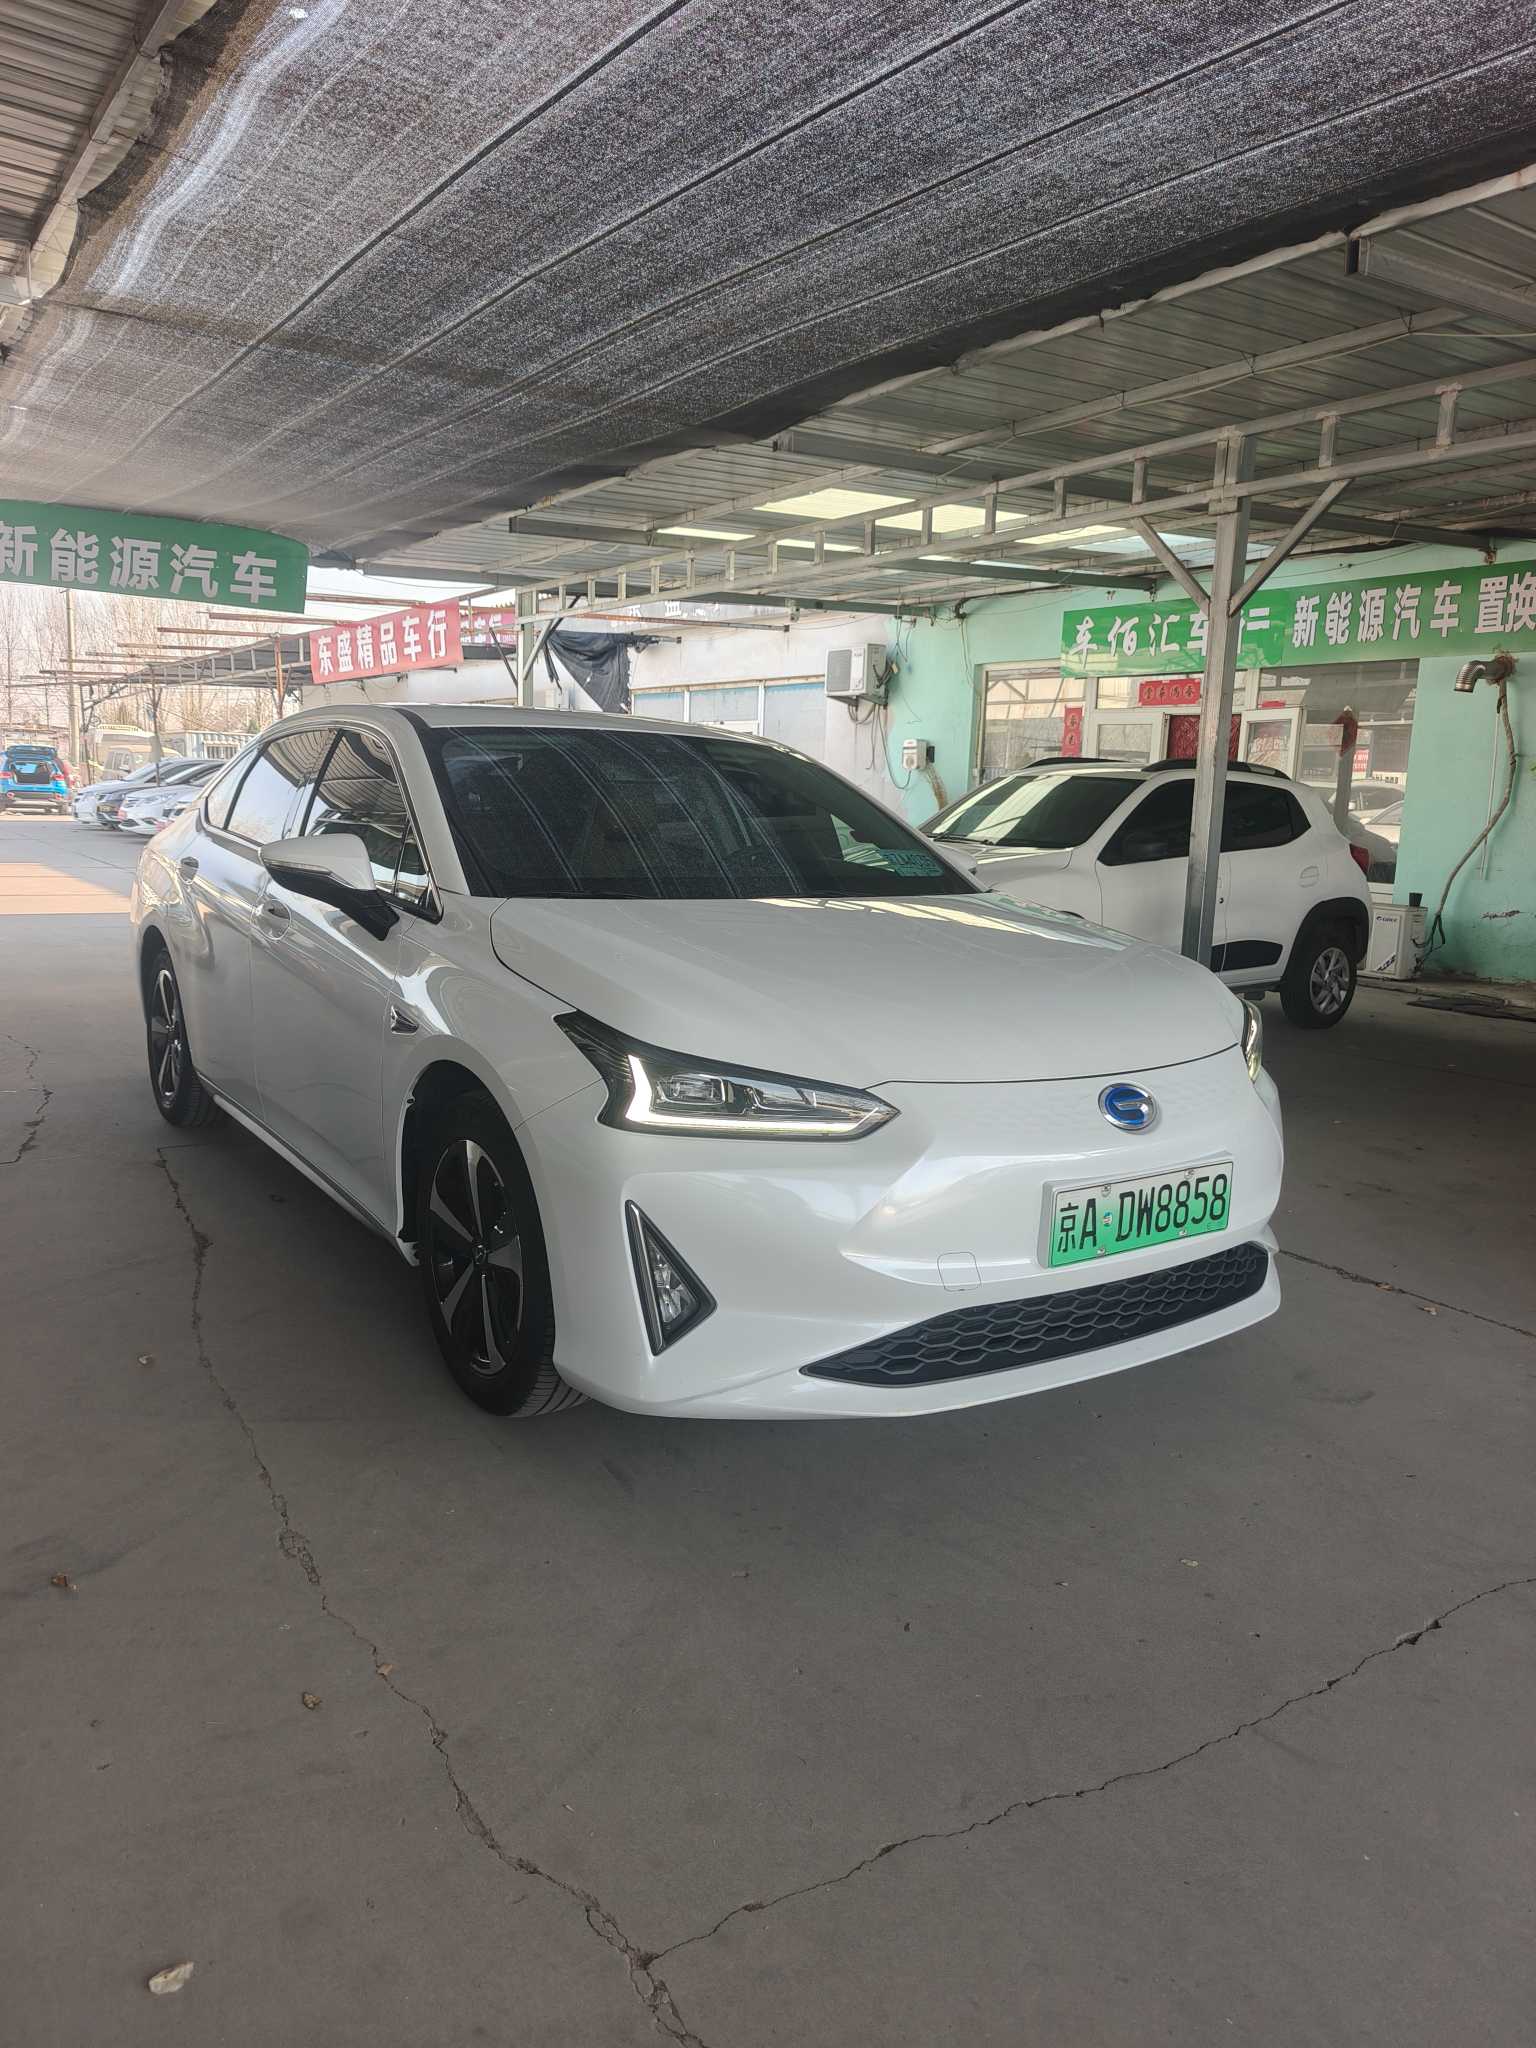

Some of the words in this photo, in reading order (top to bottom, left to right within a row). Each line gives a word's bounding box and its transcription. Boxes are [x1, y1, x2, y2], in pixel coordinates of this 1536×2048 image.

[0, 520, 278, 603] 新能源汽车
[317, 609, 448, 676] 东盛精品车行
[1292, 580, 1462, 648] 新能源汽车
